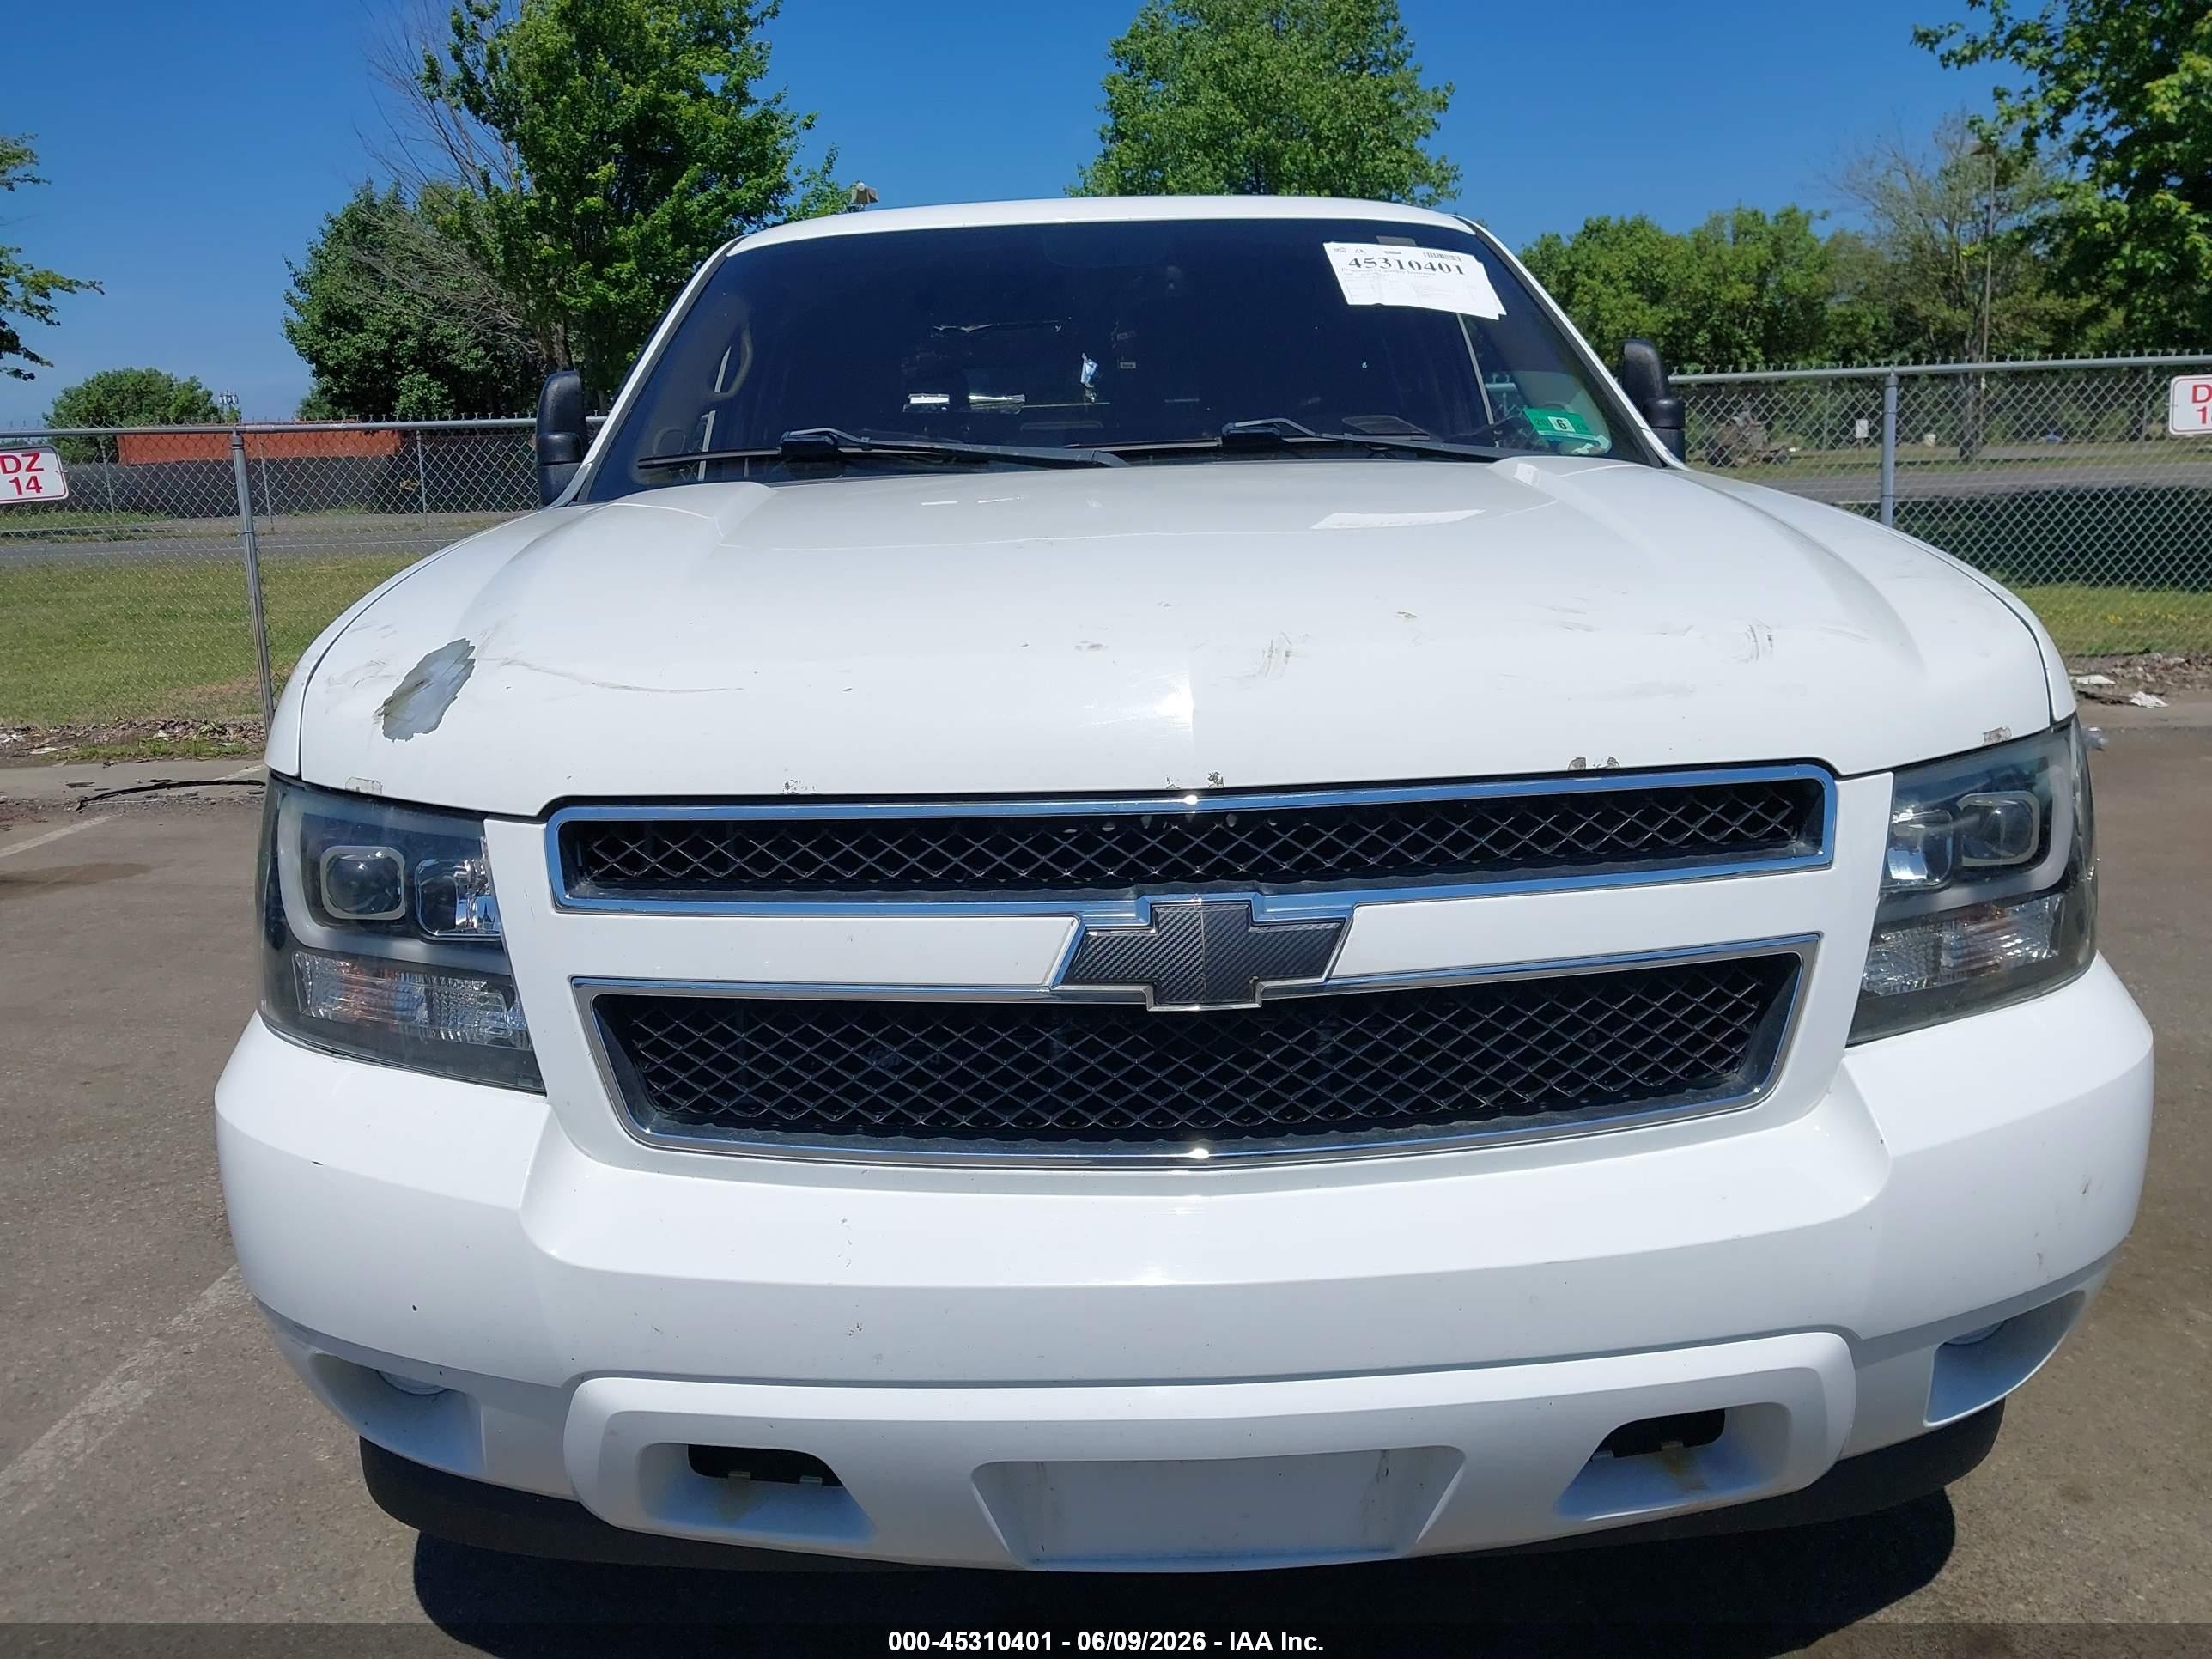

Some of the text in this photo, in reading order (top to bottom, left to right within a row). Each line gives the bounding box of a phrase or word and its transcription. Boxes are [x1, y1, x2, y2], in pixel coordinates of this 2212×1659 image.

[1348, 257, 1465, 275] 45310401
[1556, 418, 1567, 430] 6
[2196, 405, 2212, 425] 1
[0, 453, 44, 474] DZ
[9, 476, 43, 495] 14
